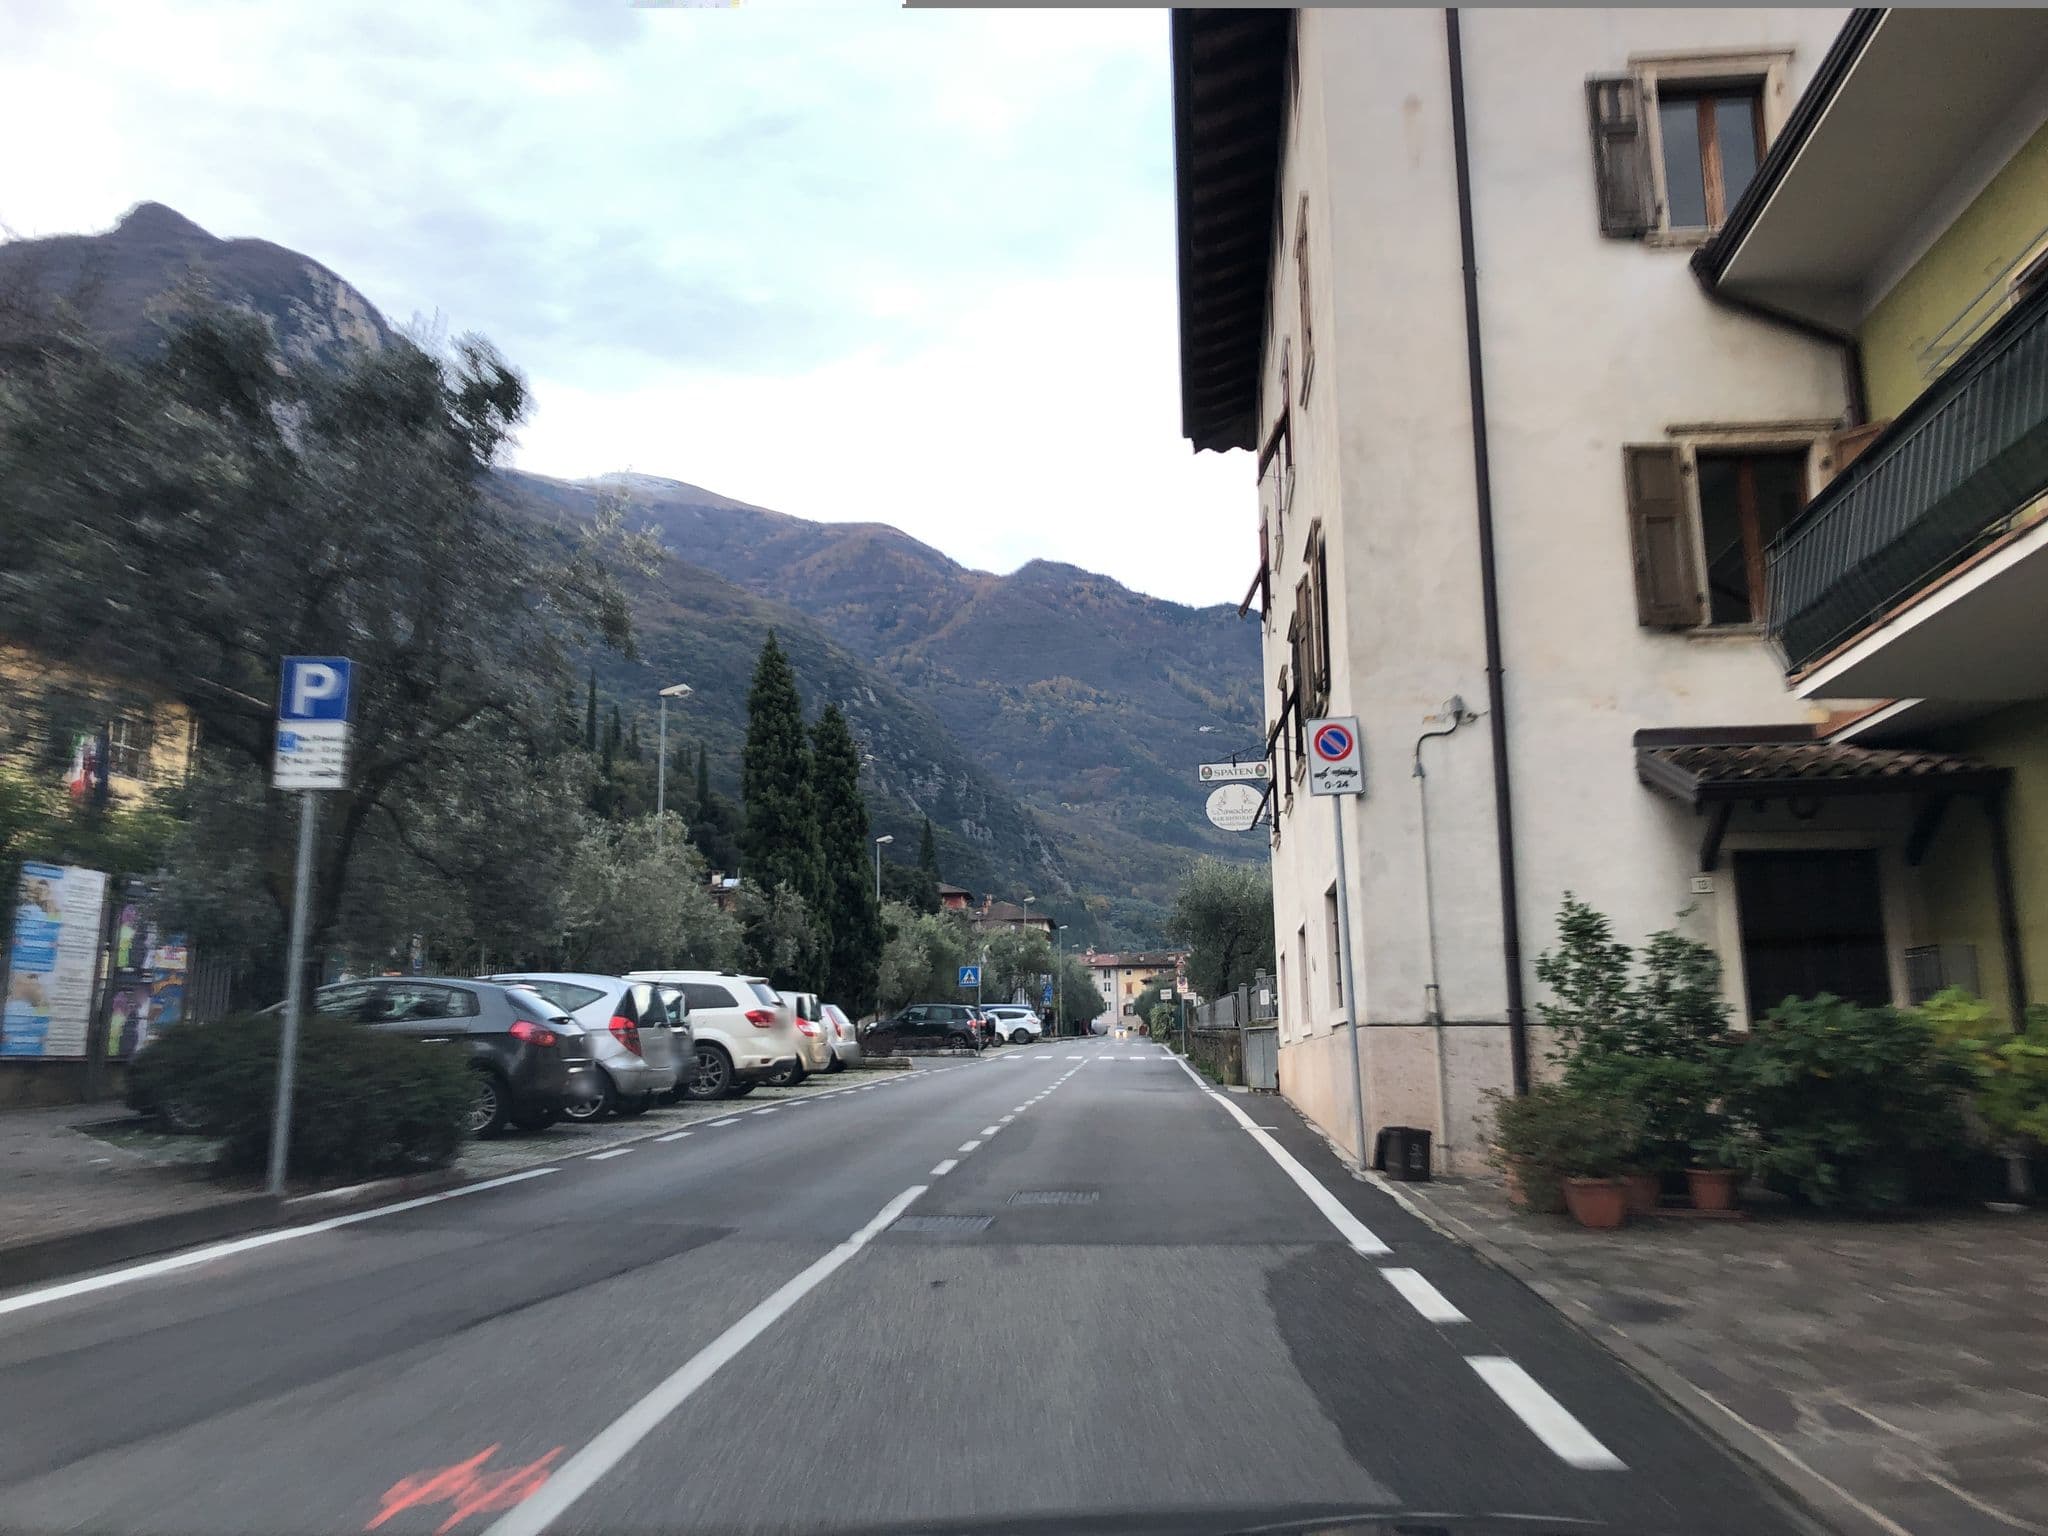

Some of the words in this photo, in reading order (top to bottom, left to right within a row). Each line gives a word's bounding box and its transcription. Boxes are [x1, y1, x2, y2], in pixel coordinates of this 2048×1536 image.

[291, 663, 339, 716] P
[1214, 768, 1254, 777] SPATEN
[1324, 780, 1349, 789] 0-24
